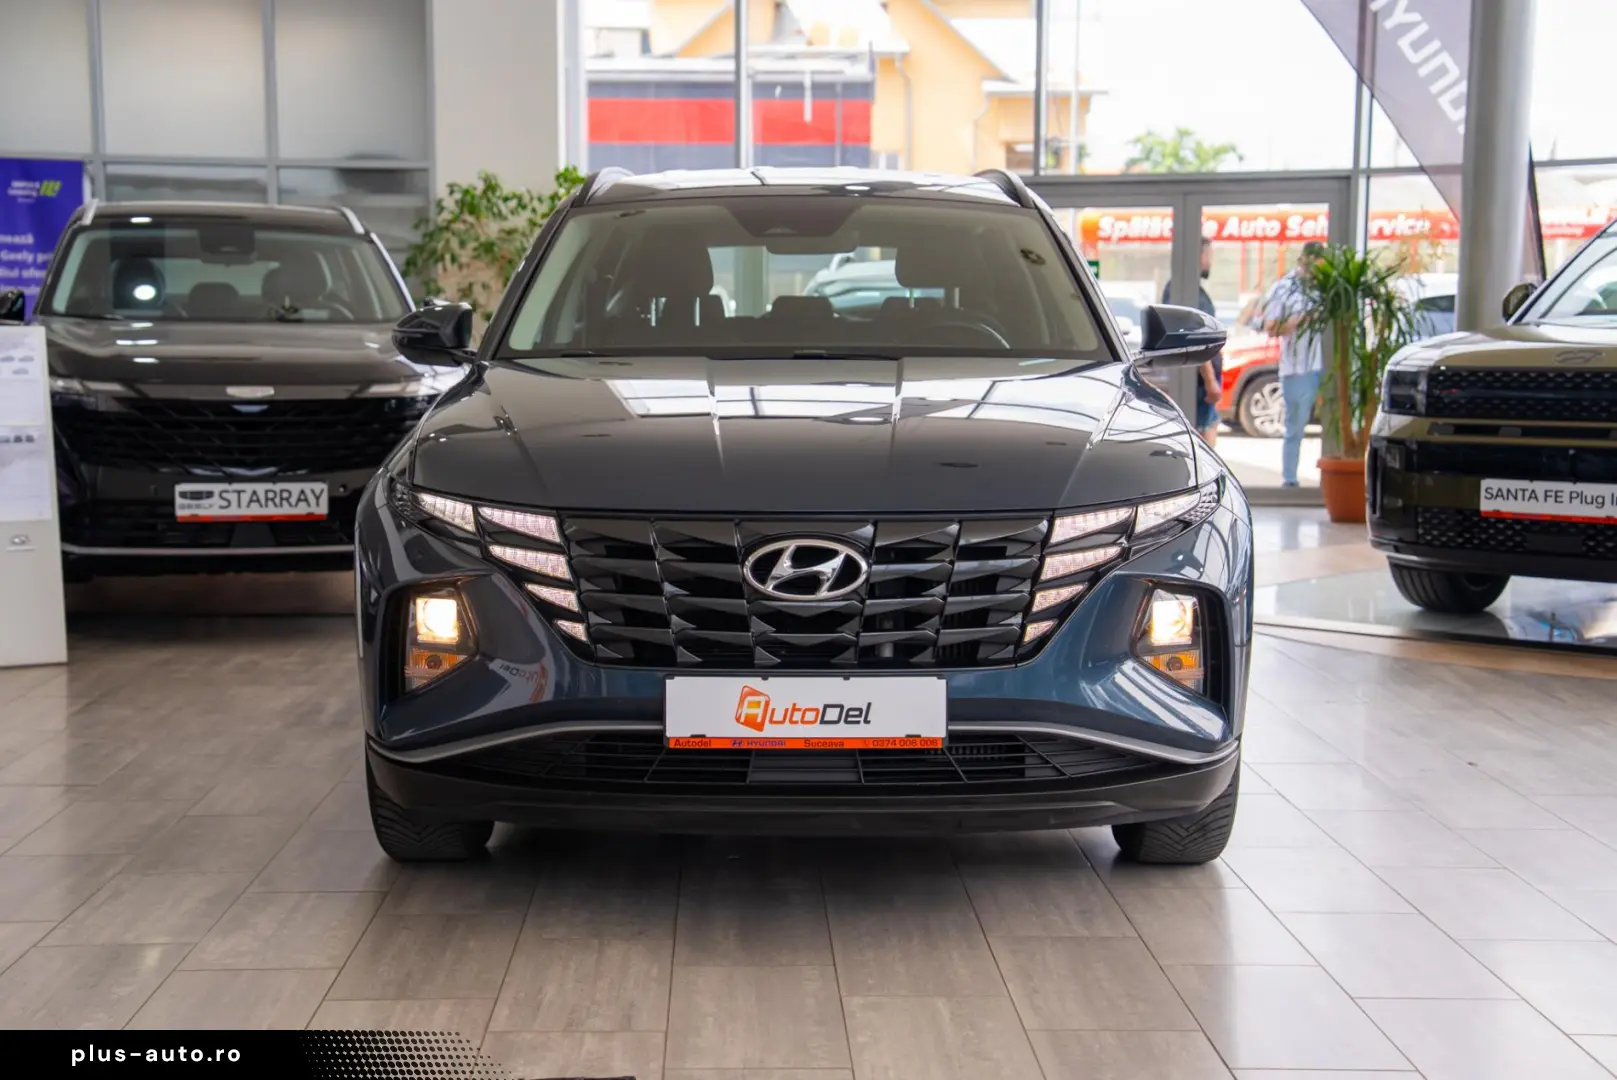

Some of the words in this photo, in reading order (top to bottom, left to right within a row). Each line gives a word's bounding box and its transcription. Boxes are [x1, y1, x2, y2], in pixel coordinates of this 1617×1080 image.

[1221, 215, 1281, 238] Auto
[1371, 214, 1431, 236] rvice
[218, 488, 325, 509] STARRAY
[1484, 487, 1539, 502] SANTA
[1544, 489, 1564, 504] FE
[1569, 491, 1606, 509] Plug
[1611, 493, 1617, 506] I
[736, 685, 872, 732] AutoDel
[674, 739, 712, 748] Autodel
[804, 739, 845, 748] Suceava
[872, 739, 897, 747] 0374
